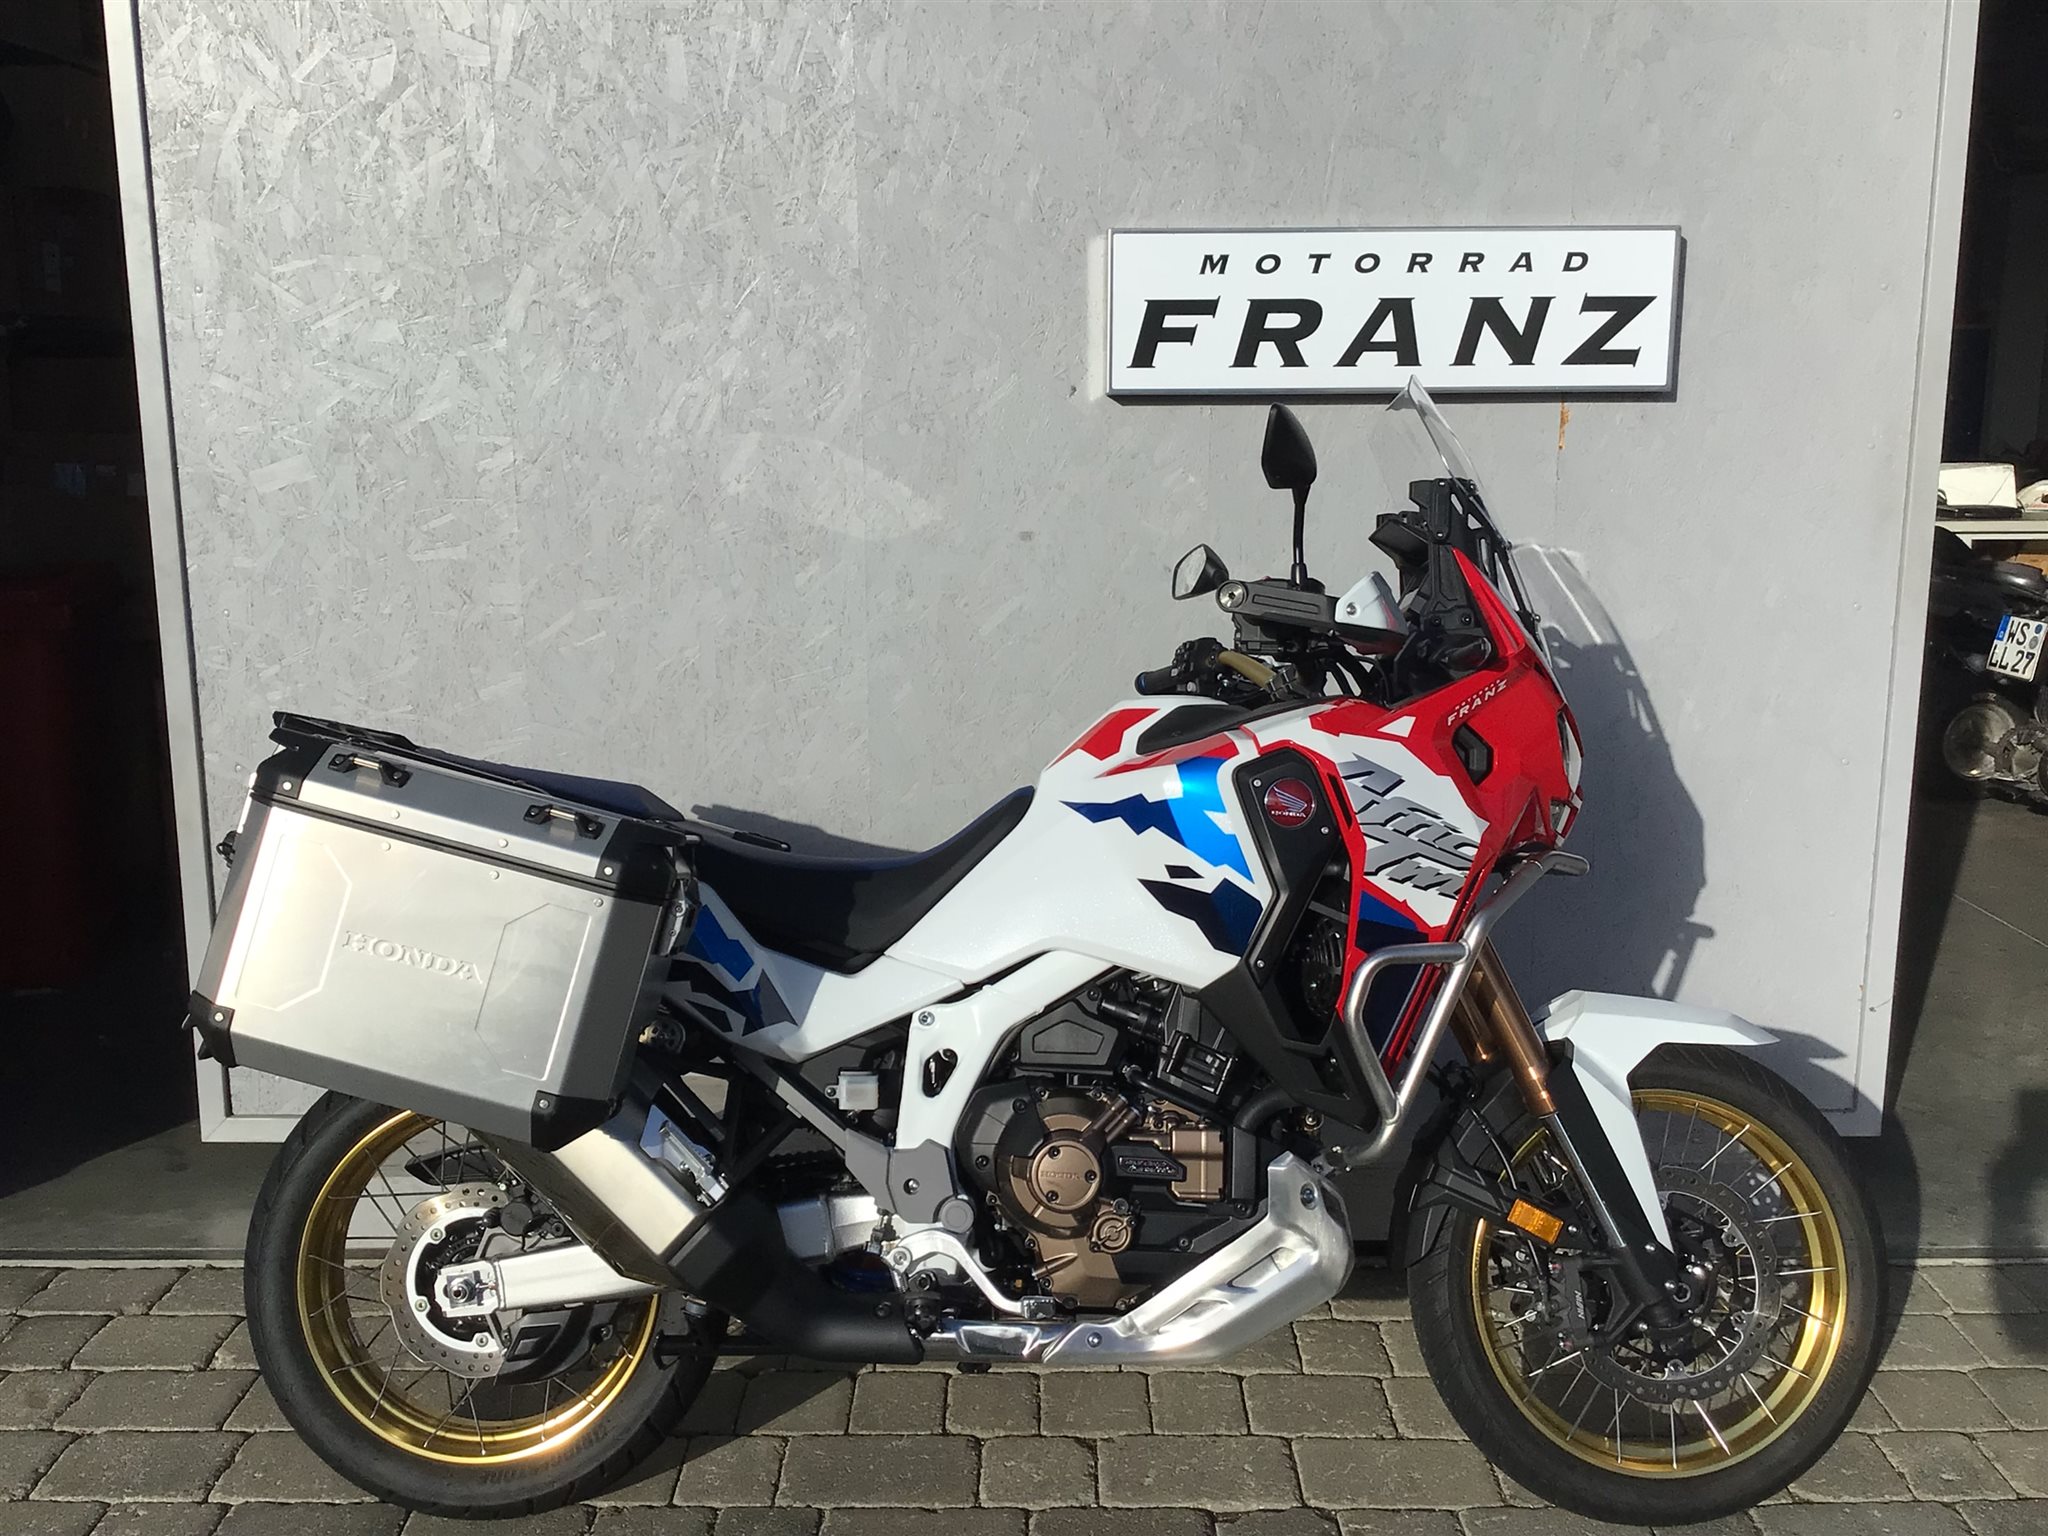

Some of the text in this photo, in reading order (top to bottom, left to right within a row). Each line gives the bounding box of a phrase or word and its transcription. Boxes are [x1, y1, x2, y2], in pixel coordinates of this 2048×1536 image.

[1199, 251, 1590, 275] MOTORRAD
[1126, 292, 1658, 368] FRANZ
[2006, 620, 2031, 646] WS
[1988, 644, 2036, 675] LL 27
[1447, 679, 1508, 726] FRANZ
[342, 930, 483, 984] HONDA
